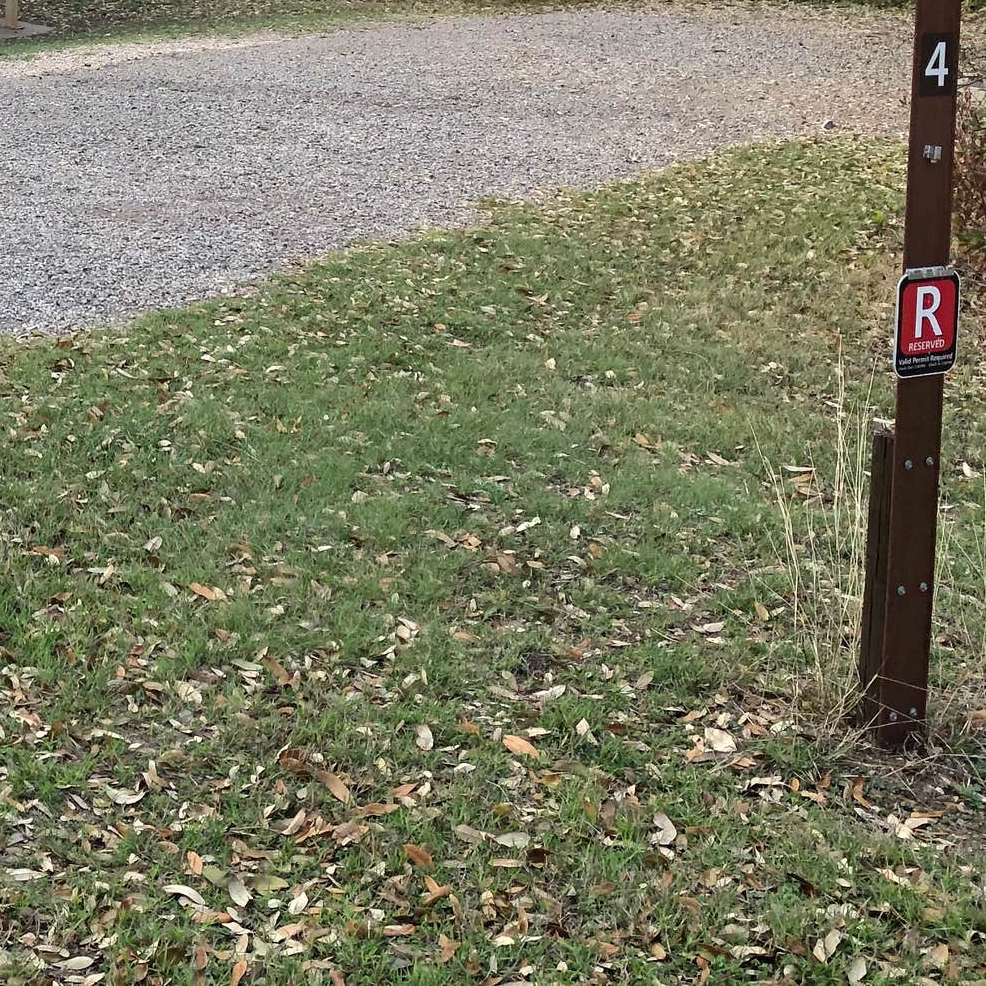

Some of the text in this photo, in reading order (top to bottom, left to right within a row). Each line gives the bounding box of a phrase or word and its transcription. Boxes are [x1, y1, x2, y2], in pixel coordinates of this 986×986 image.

[924, 41, 949, 87] 4
[915, 285, 943, 339] R
[898, 358, 912, 366] Valid
[912, 356, 930, 364] Permit
[930, 353, 953, 362] Required
[908, 339, 945, 352] RESERVED
